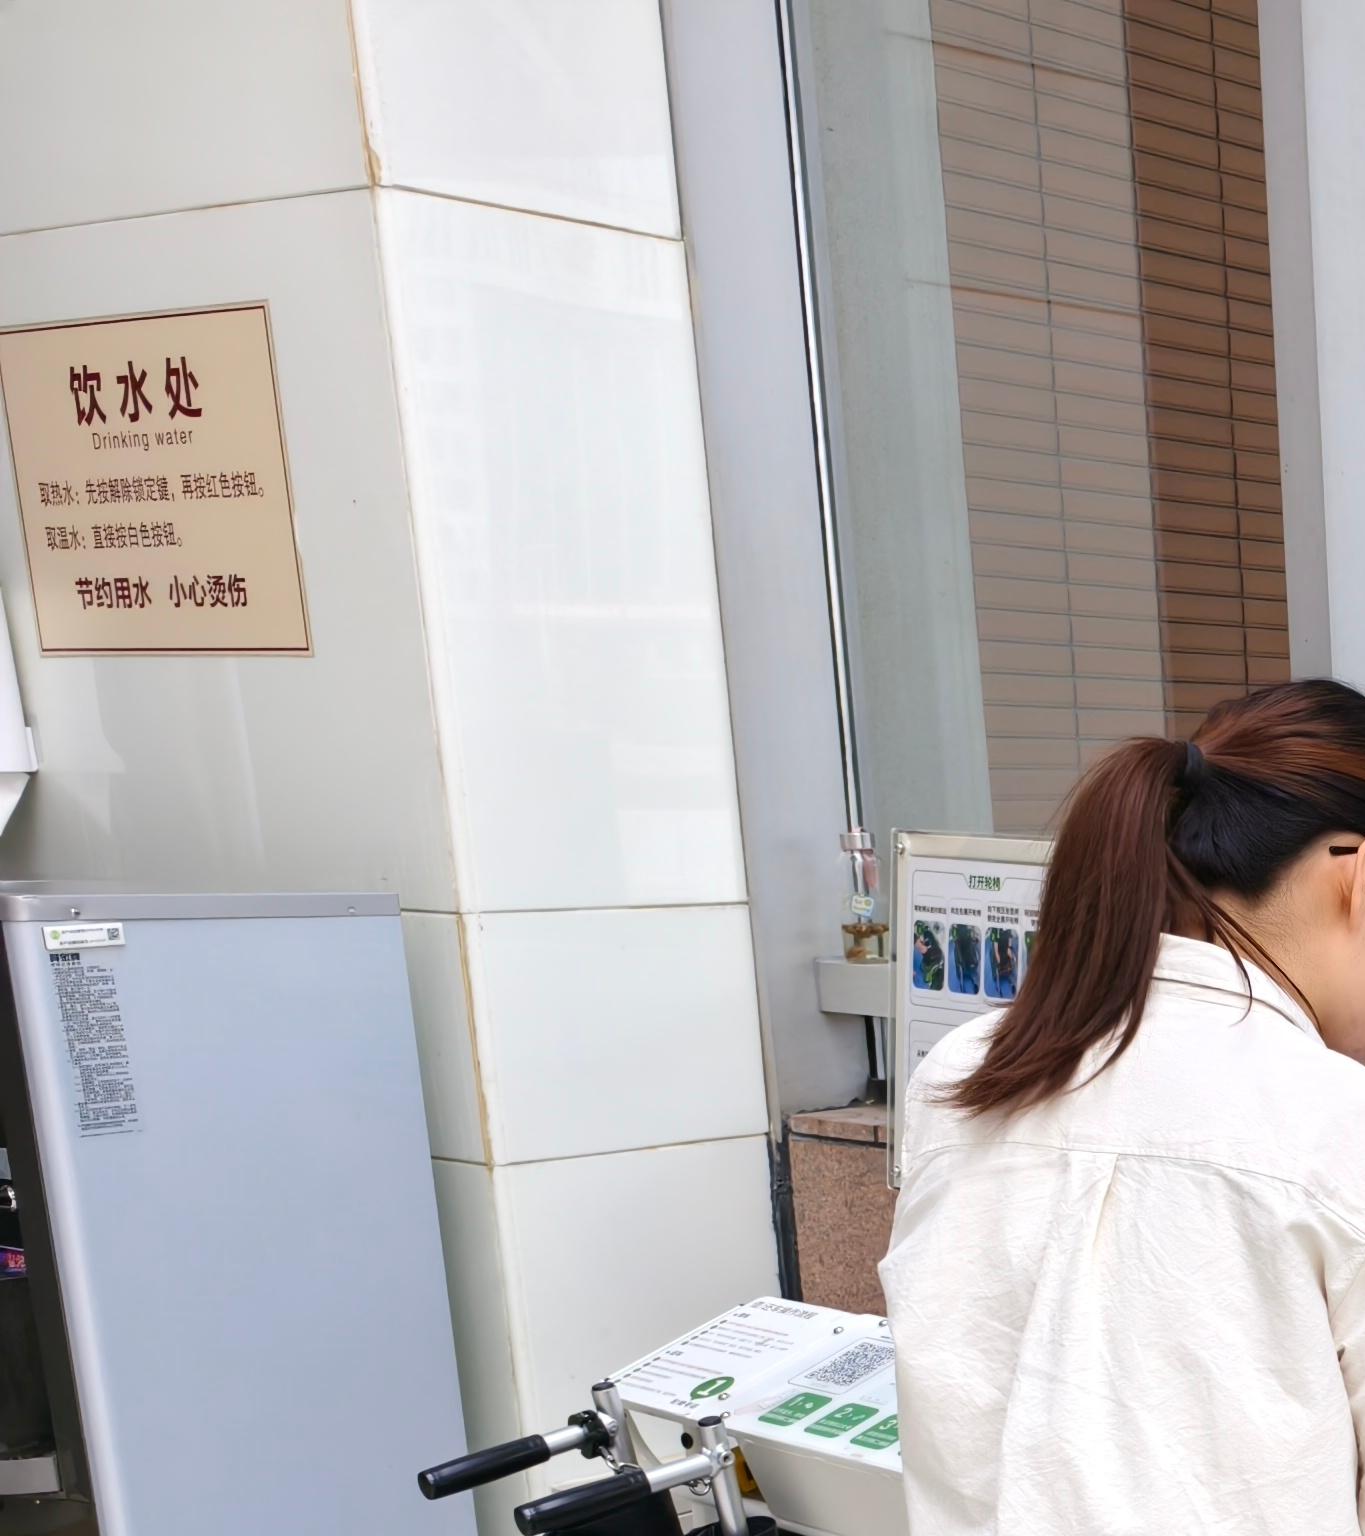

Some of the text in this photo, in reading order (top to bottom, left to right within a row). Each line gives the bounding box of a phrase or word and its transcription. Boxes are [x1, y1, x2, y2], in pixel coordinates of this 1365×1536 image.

[69, 356, 203, 426] 饮水处
[92, 427, 193, 451] Drinking water
[75, 574, 248, 609] 节约用水 小心烫伤
[969, 874, 1001, 891] 打开轮椅
